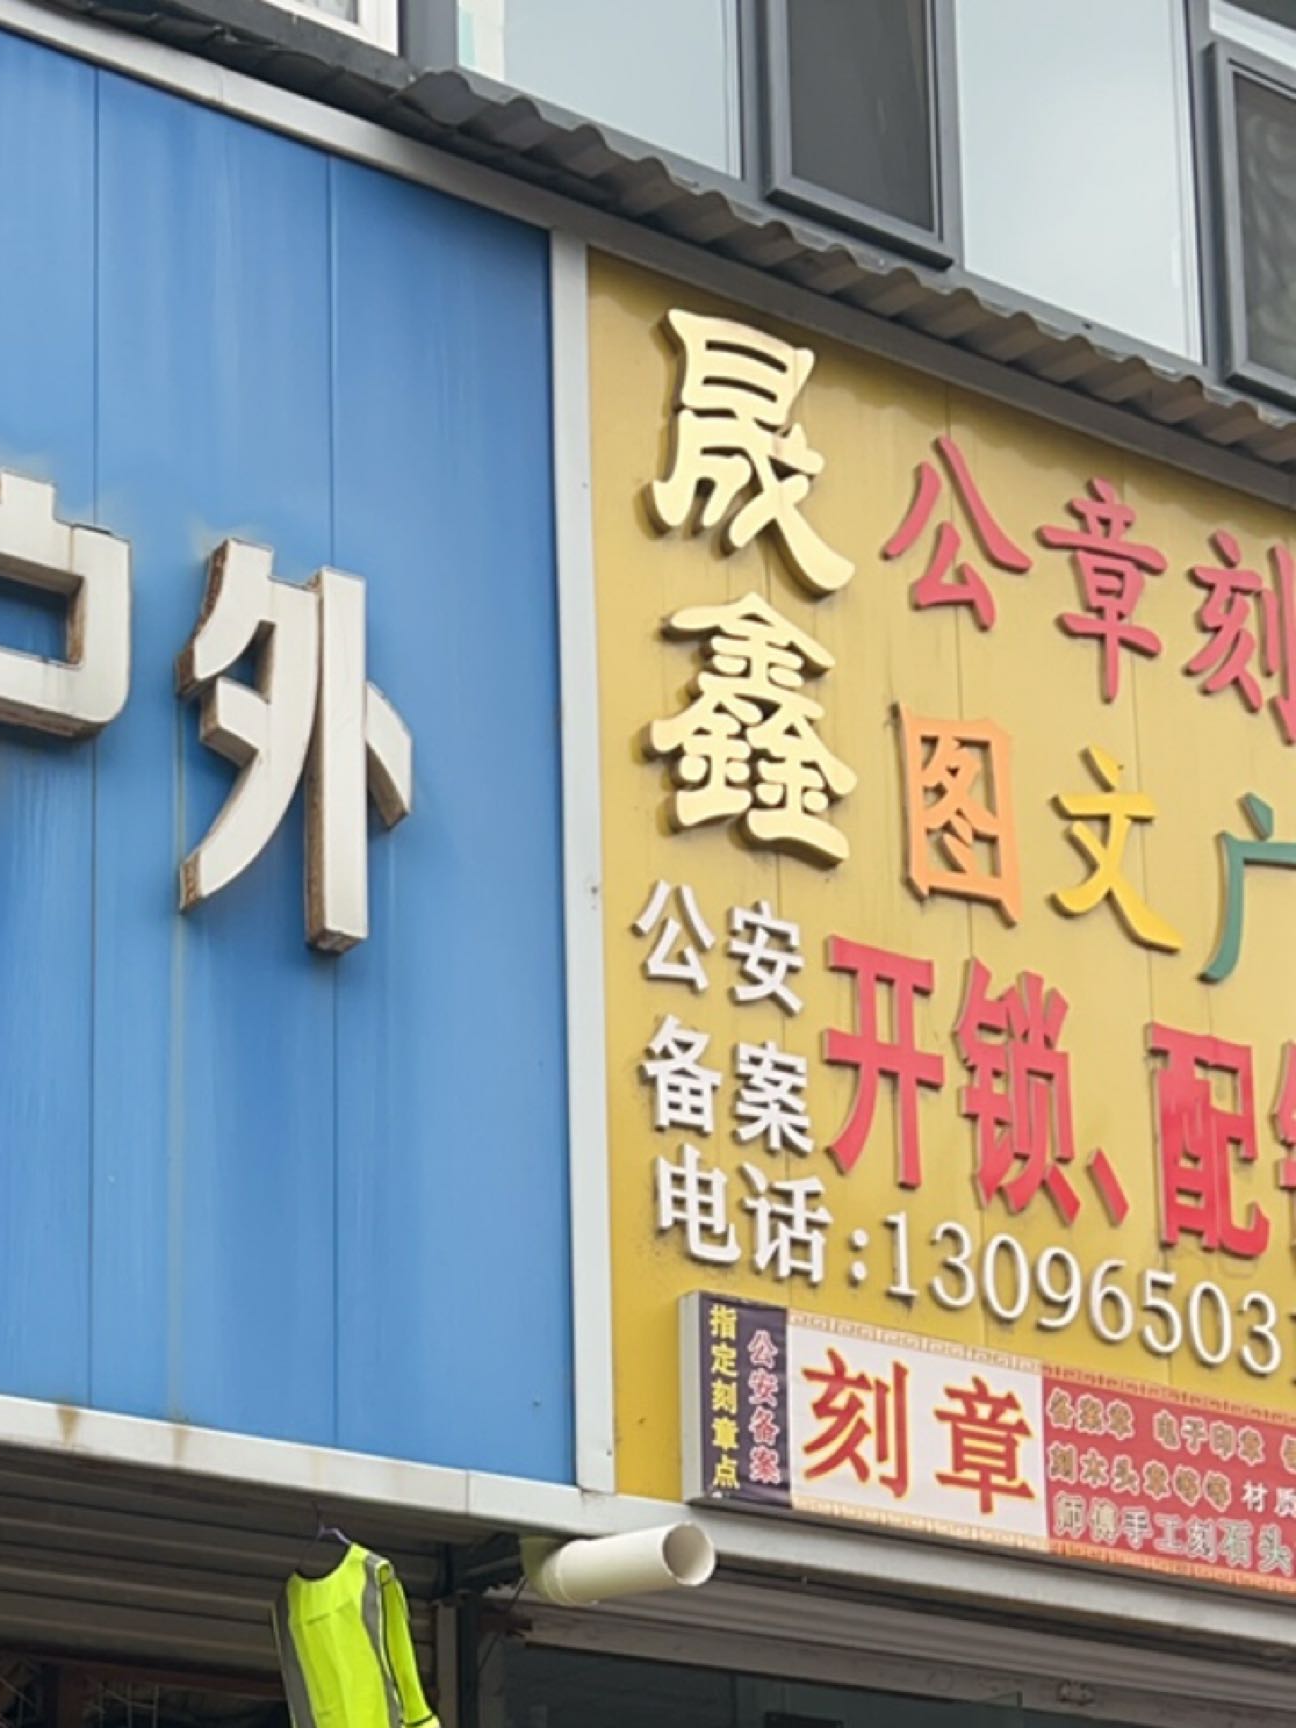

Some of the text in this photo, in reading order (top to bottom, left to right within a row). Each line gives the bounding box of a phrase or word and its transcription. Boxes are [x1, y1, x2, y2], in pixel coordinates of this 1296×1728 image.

[647, 306, 857, 868] 晟鑫
[880, 433, 1296, 746] 公章刻
[632, 878, 805, 1014] 公安
[641, 1014, 815, 1154] 备案
[821, 934, 1296, 1258] 开锁、配
[654, 1142, 1296, 1377] 电话:13096503
[709, 1304, 741, 1490] 指定刻章点
[748, 1330, 782, 1484] 公安备案
[801, 1346, 1036, 1514] 刻章
[1152, 1408, 1267, 1467] 电子印章
